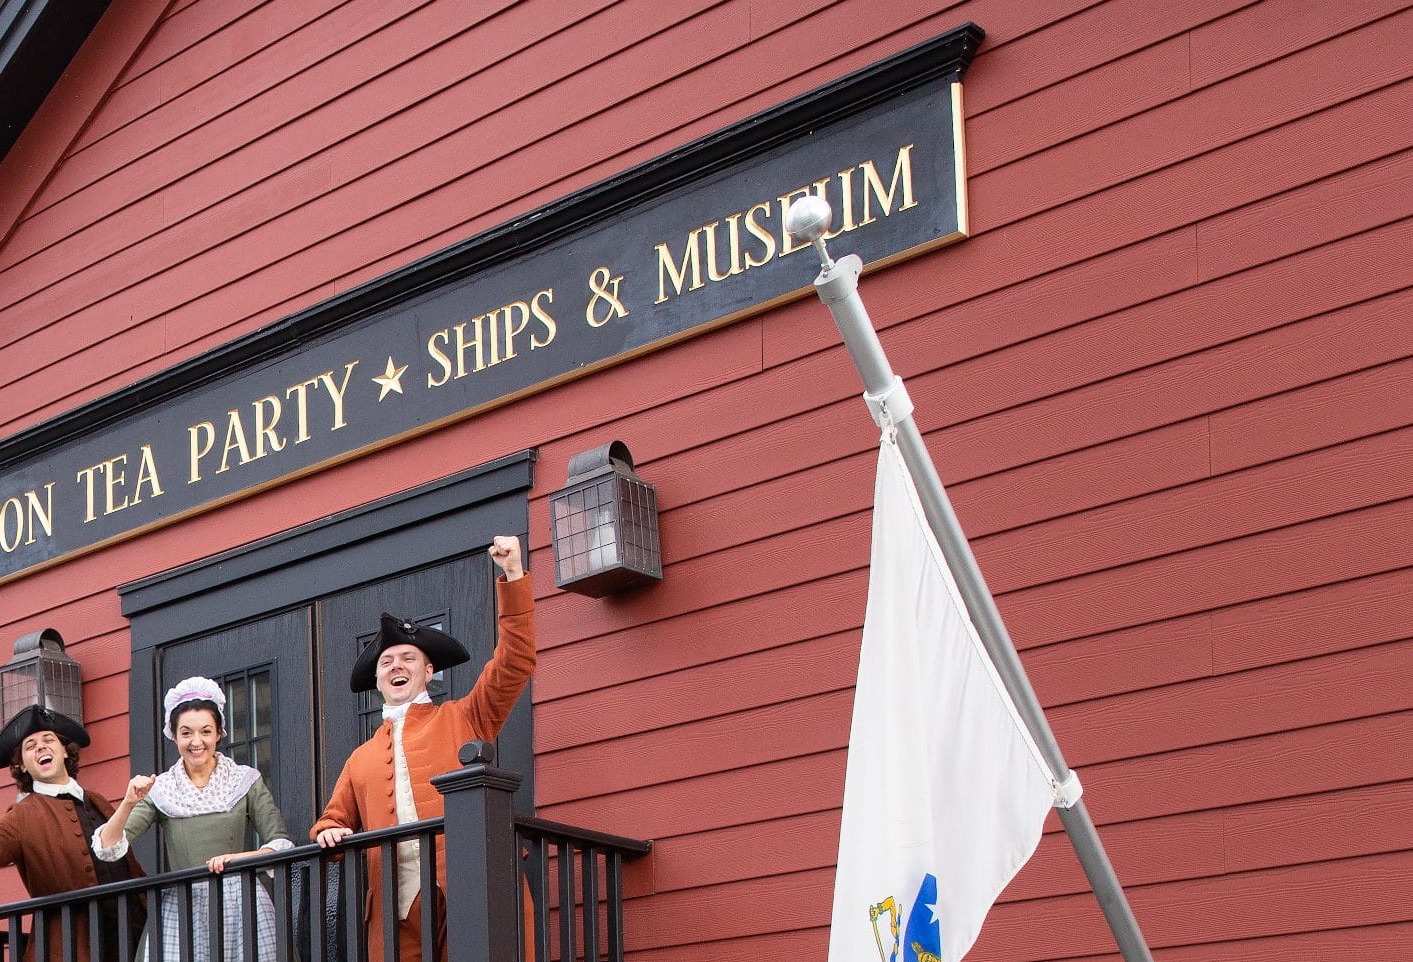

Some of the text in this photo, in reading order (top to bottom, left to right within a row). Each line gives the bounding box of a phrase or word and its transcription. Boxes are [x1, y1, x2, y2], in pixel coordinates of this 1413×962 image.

[77, 444, 165, 524] TEA
[187, 359, 360, 485] PARTY
[426, 288, 557, 389] SHIPS
[585, 266, 630, 328] &
[654, 143, 919, 305] MUSEUM
